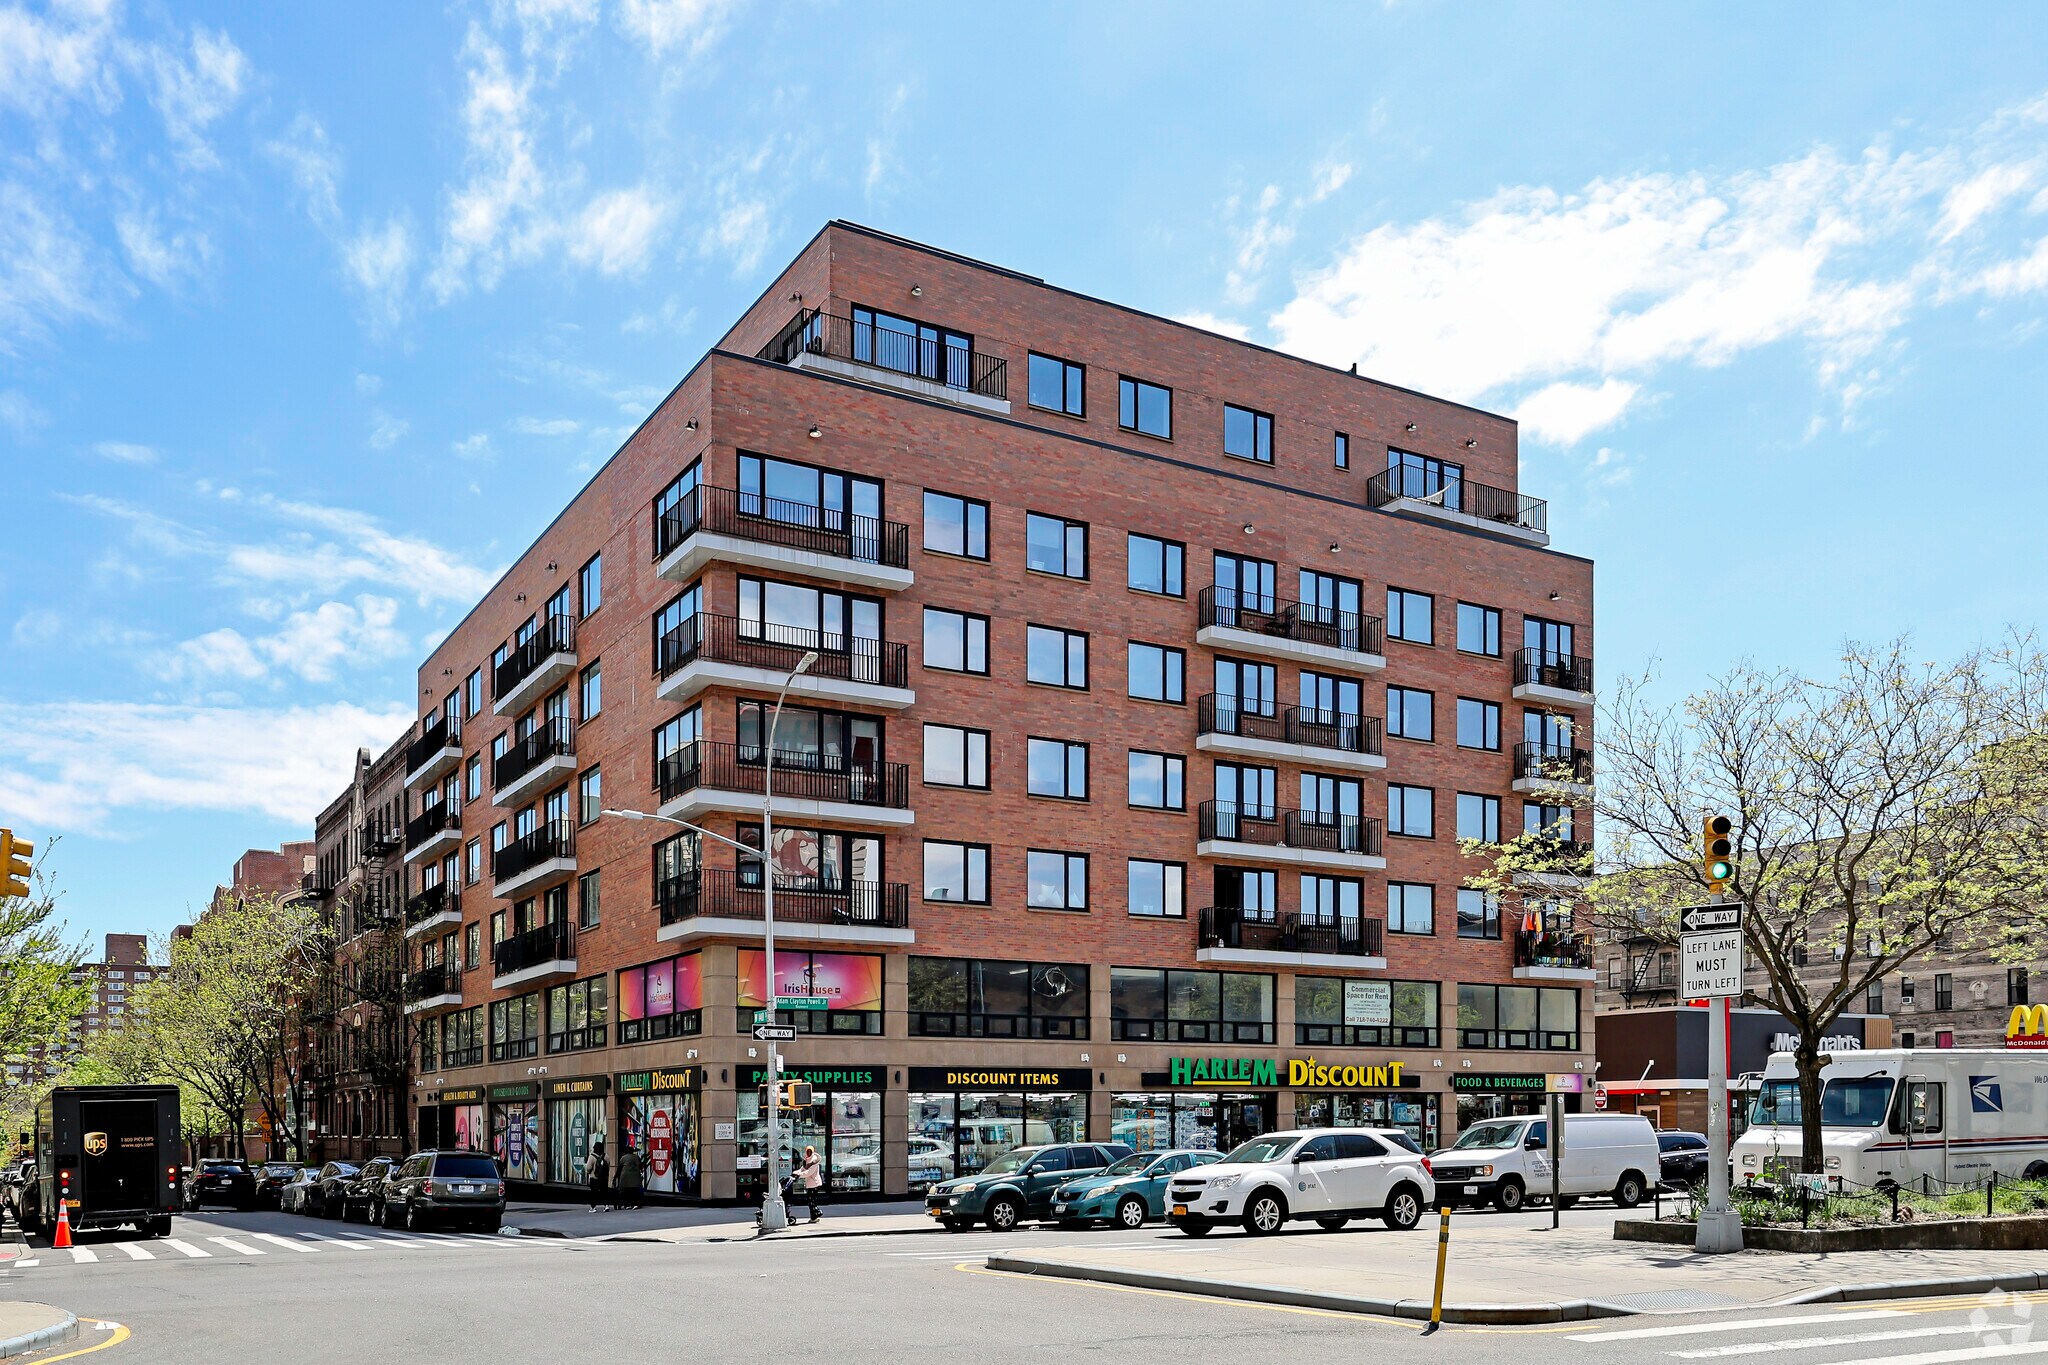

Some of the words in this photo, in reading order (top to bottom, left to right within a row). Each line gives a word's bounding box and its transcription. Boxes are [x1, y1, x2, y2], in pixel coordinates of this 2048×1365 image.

[1689, 914, 1706, 924] ONE
[1714, 912, 1734, 922] WAY
[1687, 942, 1708, 954] LEFT
[1713, 939, 1737, 951] LANE
[1696, 958, 1727, 972] MUST
[1687, 980, 1710, 991] TURN
[1715, 977, 1737, 989] LEFT
[789, 997, 807, 1006] Clayton
[1346, 992, 1364, 1000] Space
[758, 1029, 772, 1037] ONE
[1773, 1033, 1861, 1051] Mcnald's
[752, 1071, 799, 1083] PATY
[804, 1071, 872, 1083] SUPPLIES
[1170, 1057, 1278, 1085] HARLEM
[620, 1073, 650, 1091] HARLEM
[947, 1073, 1016, 1084] DISCOUNT
[1020, 1073, 1059, 1085] ITEMS
[1456, 1077, 1482, 1087] FOOD
[1485, 1078, 1491, 1087] &
[1494, 1078, 1544, 1088] BEVERAGES
[515, 1086, 529, 1096] GOODS
[553, 1083, 567, 1093] LINEN
[571, 1081, 593, 1092] CURTAINS
[86, 1139, 106, 1153] ups
